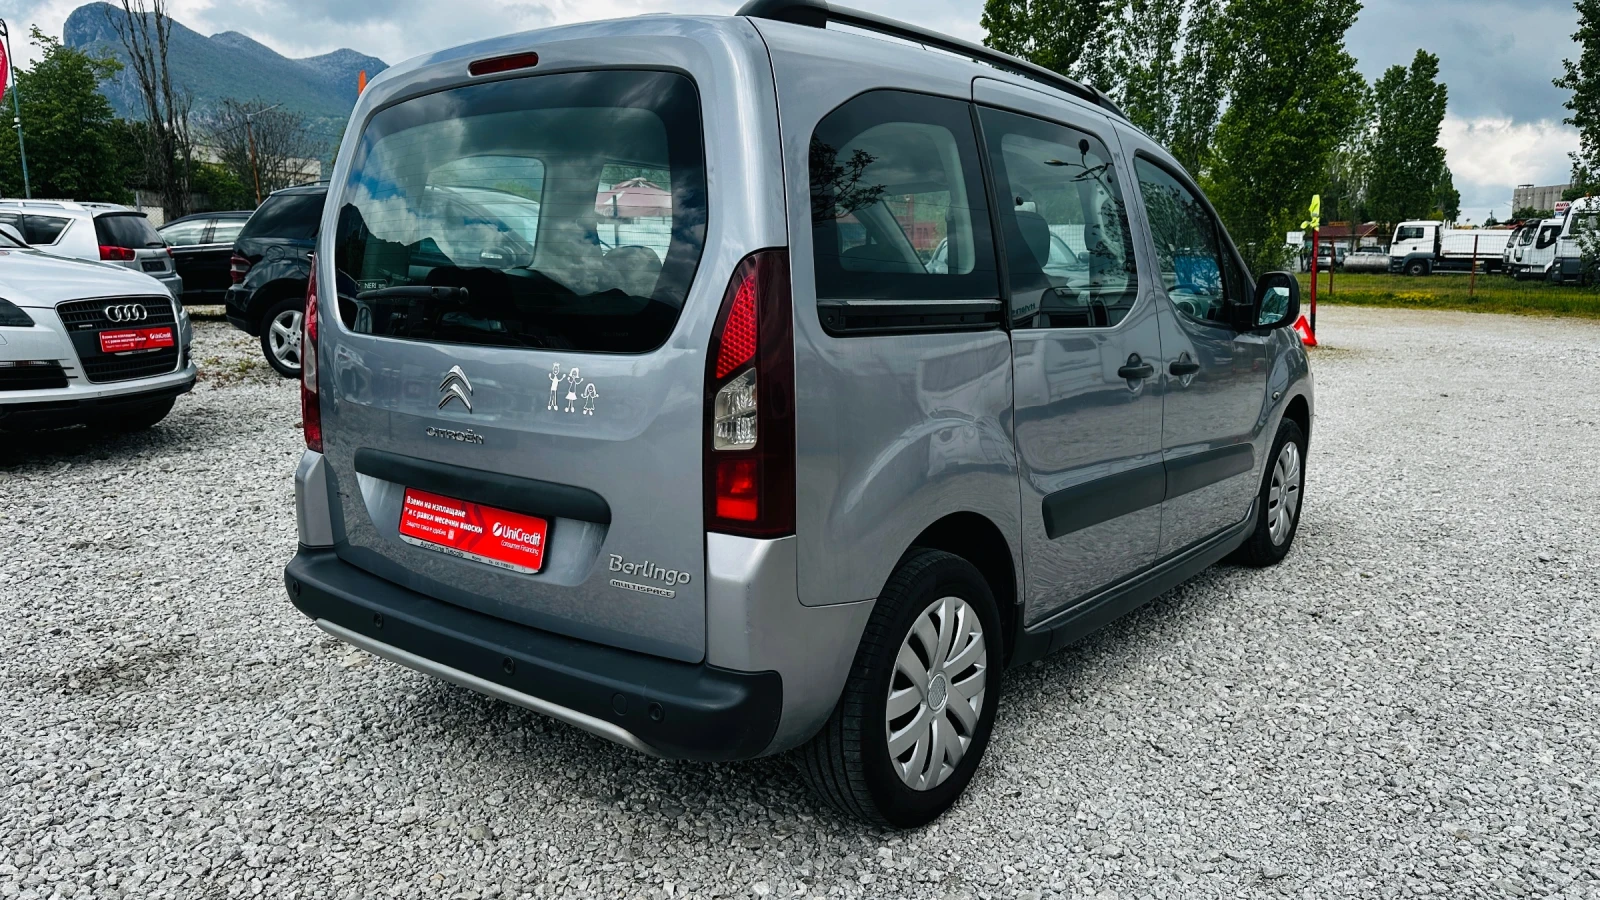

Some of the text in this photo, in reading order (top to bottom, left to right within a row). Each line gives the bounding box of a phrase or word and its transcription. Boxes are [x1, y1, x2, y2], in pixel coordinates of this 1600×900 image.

[426, 426, 484, 444] CITROËN
[406, 495, 466, 518] Вземи на изплащане
[417, 511, 434, 521] равни
[434, 515, 459, 528] месечни
[460, 522, 483, 534] вноски
[503, 525, 541, 547] UniCredit
[520, 545, 539, 556] Financing
[609, 553, 691, 586] Berlingo
[612, 581, 672, 596] MULTISPACE
